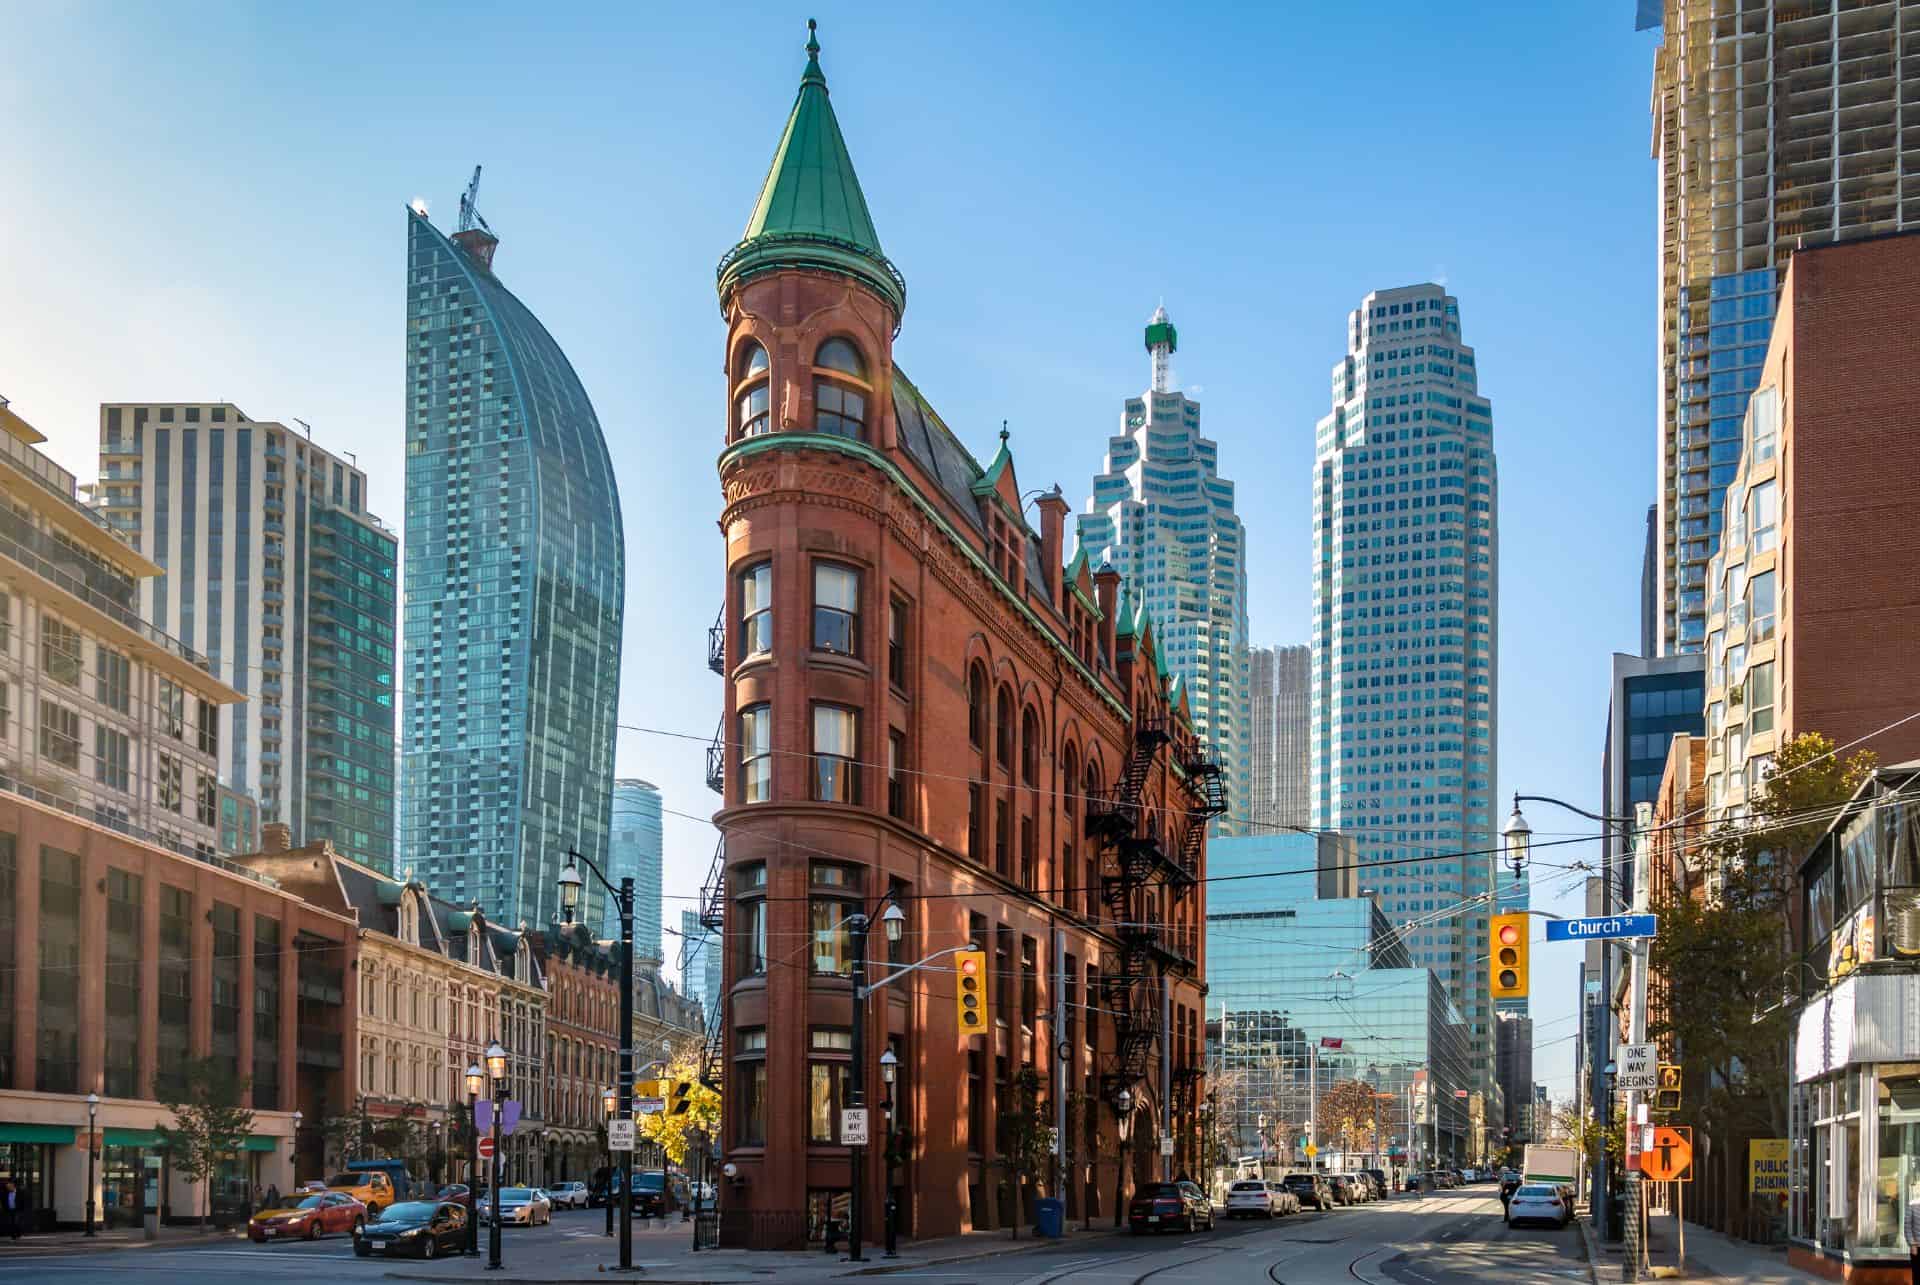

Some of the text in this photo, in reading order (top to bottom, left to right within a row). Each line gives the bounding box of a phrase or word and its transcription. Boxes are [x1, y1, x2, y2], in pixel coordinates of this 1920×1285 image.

[1567, 918, 1633, 935] Church St
[1627, 1047, 1647, 1058] ONE
[1627, 1062, 1647, 1072] WAY
[1619, 1076, 1655, 1088] BEGINS
[847, 1111, 862, 1120] ONE
[848, 1123, 861, 1131] WAY
[842, 1134, 866, 1142] BEGINS
[1754, 1160, 1789, 1173] PUBLIC
